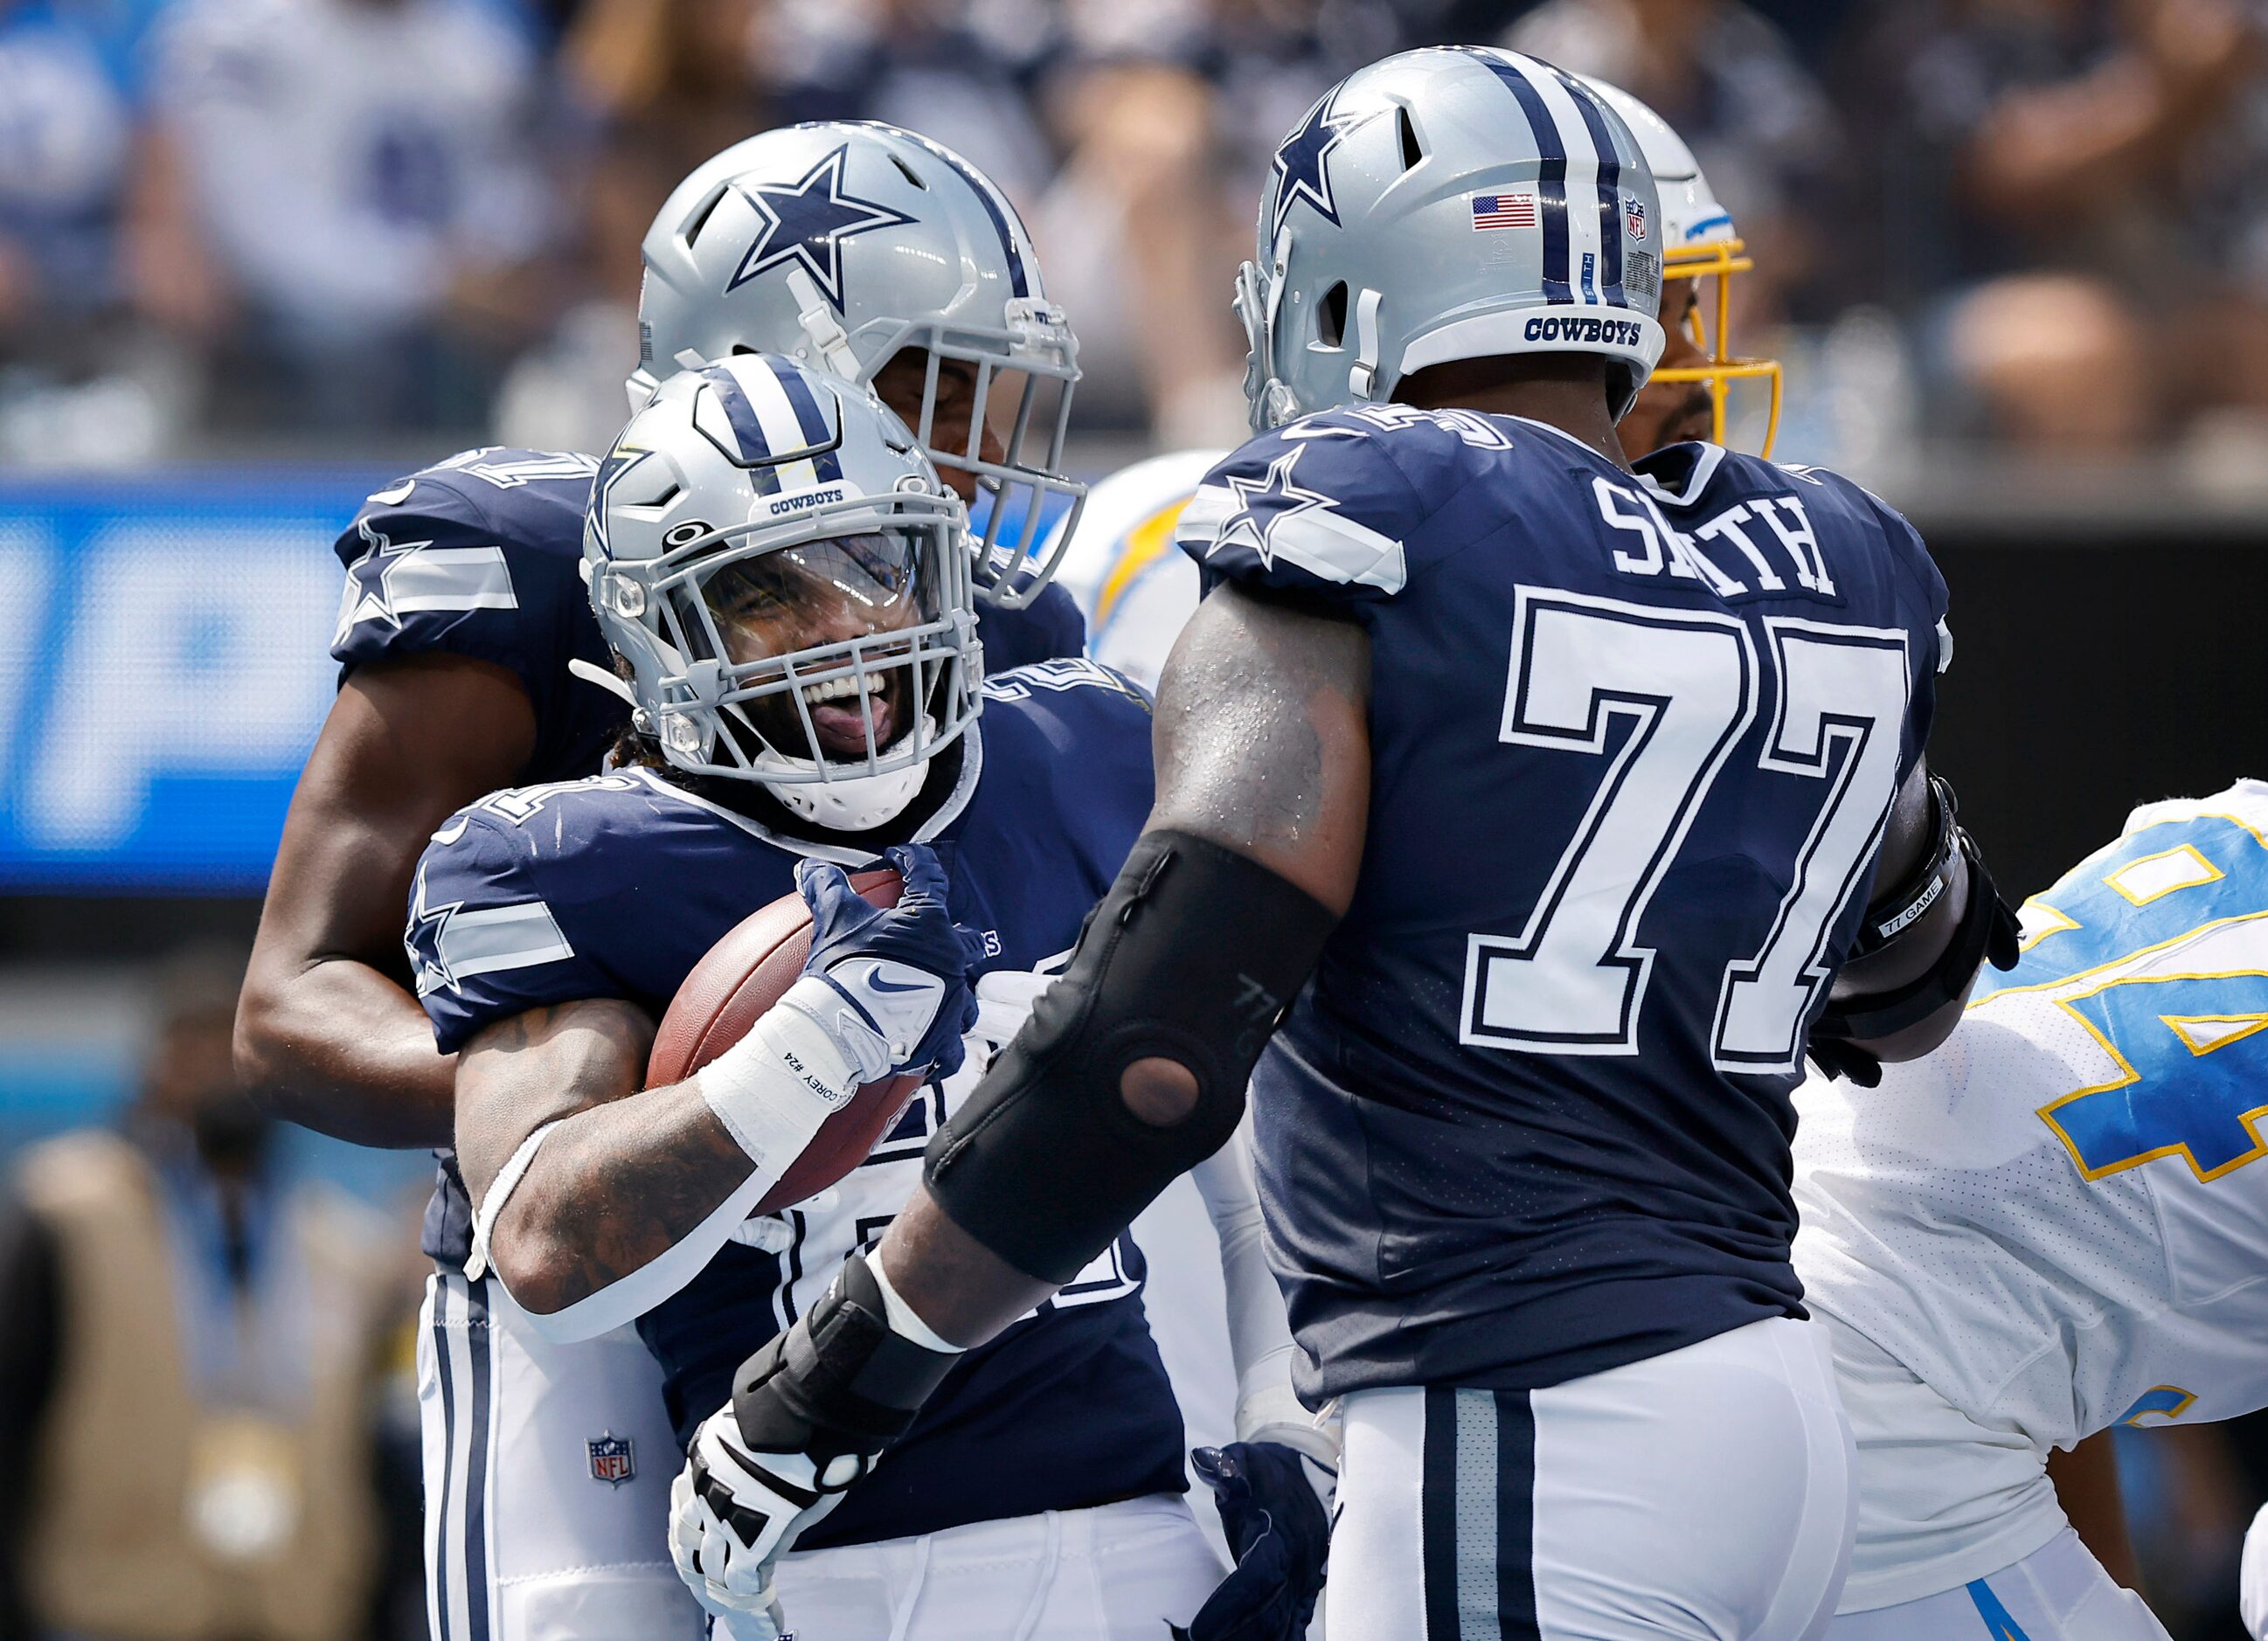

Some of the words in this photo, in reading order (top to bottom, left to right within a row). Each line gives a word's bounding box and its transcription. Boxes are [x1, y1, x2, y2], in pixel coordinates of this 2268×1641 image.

[1628, 214, 1645, 239] NFL
[1523, 317, 1641, 346] COWBOYS
[770, 489, 843, 515] COWBOYS
[0, 517, 339, 849] P
[1460, 584, 1911, 1074] 77
[1884, 917, 1902, 933] 77
[1905, 881, 1939, 919] GAME
[1232, 973, 1278, 1021] 77
[784, 1052, 804, 1072] #24
[802, 1075, 838, 1102] COREY
[595, 1456, 628, 1478] NFL
